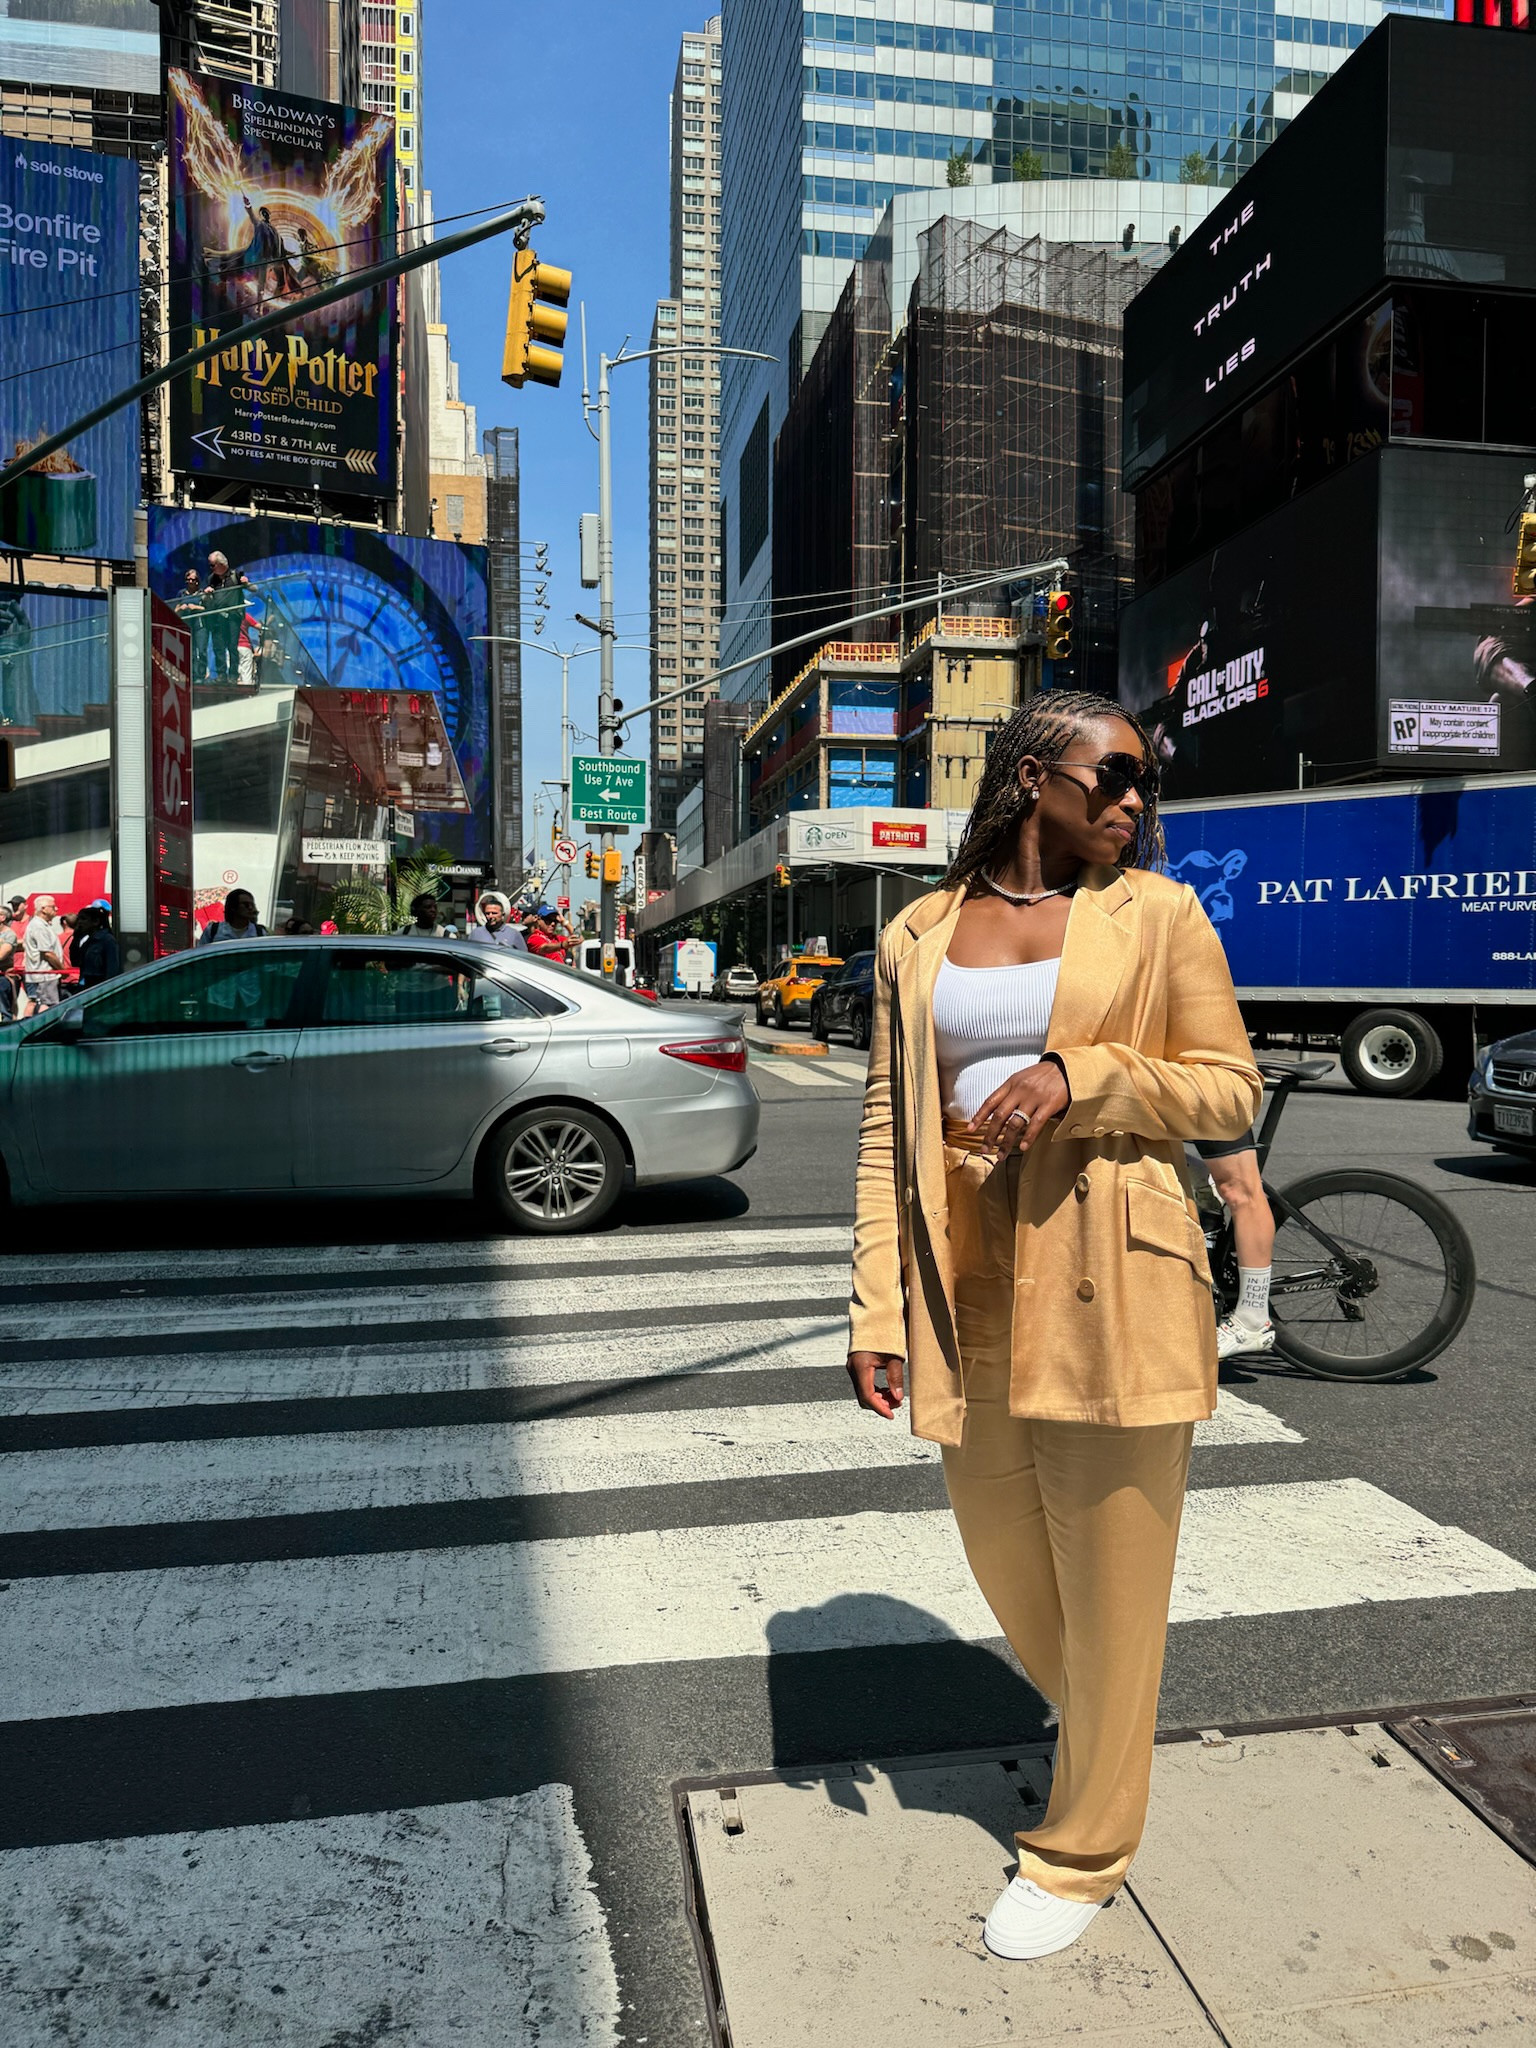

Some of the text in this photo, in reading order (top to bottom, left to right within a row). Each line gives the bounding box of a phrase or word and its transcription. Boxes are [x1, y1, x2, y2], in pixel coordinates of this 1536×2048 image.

[232, 93, 336, 129] BROADWAY'S
[244, 112, 323, 139] SPELLBINDING
[244, 124, 324, 152] SPECTACULAR
[30, 160, 104, 184] solo stove
[0, 203, 101, 244] Bonfire
[1209, 200, 1254, 256] THE
[58, 247, 98, 278] Pit
[1193, 252, 1272, 337] TRUTH
[188, 328, 378, 402] Harry Potter
[1205, 337, 1256, 393] LIES
[230, 386, 343, 415] CURSED CHILD
[273, 386, 310, 398] AND THE
[234, 408, 336, 430] HarryPotterBroadway.com
[231, 430, 337, 454] 43RD ST & 7TH AVE
[230, 448, 337, 469] NO FEES AT THE BOX OFFICE
[1187, 647, 1264, 708] CALL OF DUTY
[1182, 678, 1269, 728] BLACK OPS 6
[1422, 704, 1447, 712] LIKELY
[1448, 705, 1482, 713] MATURE
[162, 629, 186, 816] tkts
[1394, 717, 1417, 740] RP
[1430, 718, 1489, 728] May contain content
[578, 760, 640, 774] Southbound
[584, 774, 634, 787] Use 7 Ave
[580, 807, 638, 820] Best Route
[306, 841, 379, 852] PEDESTRIAN FLOW ZONE
[824, 830, 848, 840] OPEN
[340, 852, 380, 861] KEEP MOVING
[1256, 878, 1333, 905] PAT
[1461, 901, 1496, 912] MEAT
[1246, 1284, 1268, 1292] FOR
[1246, 1292, 1266, 1300] THE
[1242, 1299, 1264, 1308] PICS
